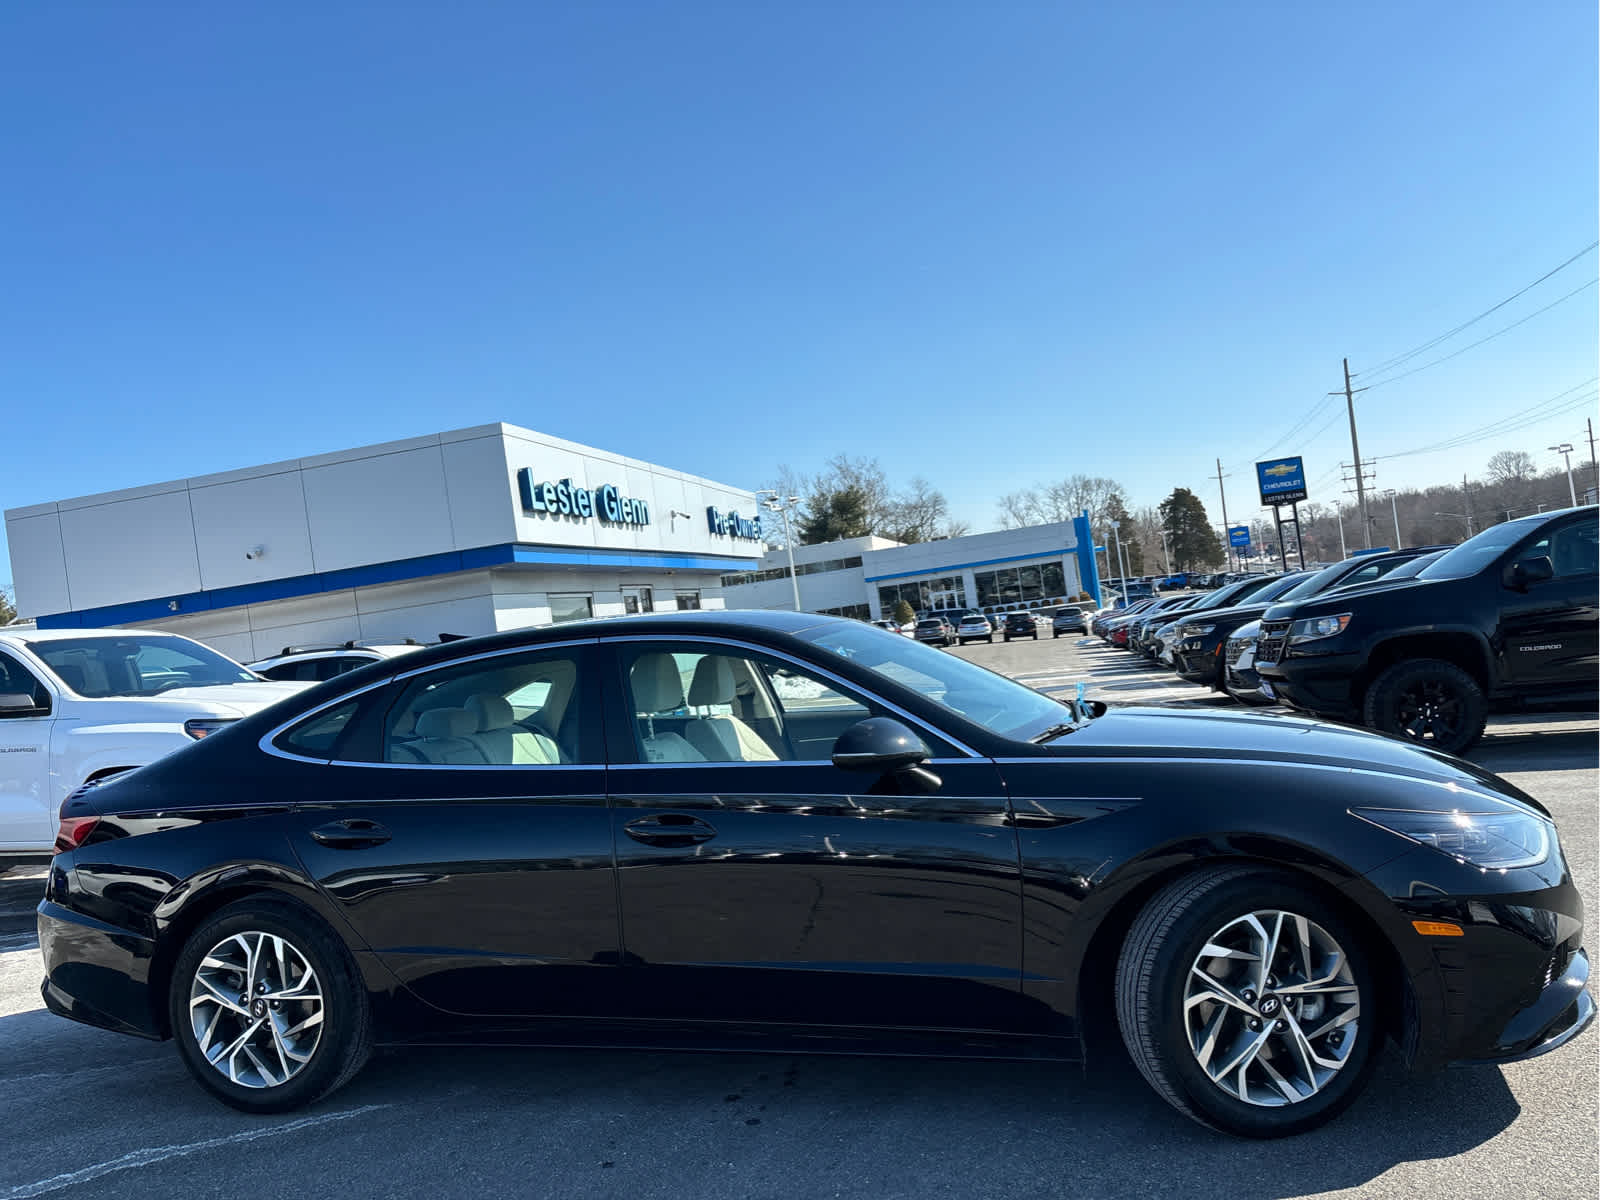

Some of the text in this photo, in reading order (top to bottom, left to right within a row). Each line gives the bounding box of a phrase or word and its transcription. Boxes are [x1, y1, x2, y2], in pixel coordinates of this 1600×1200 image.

[1263, 479, 1301, 489] CHEVROLET
[517, 467, 650, 525] Lester Glenn
[1264, 492, 1304, 502] LESTER GLENN
